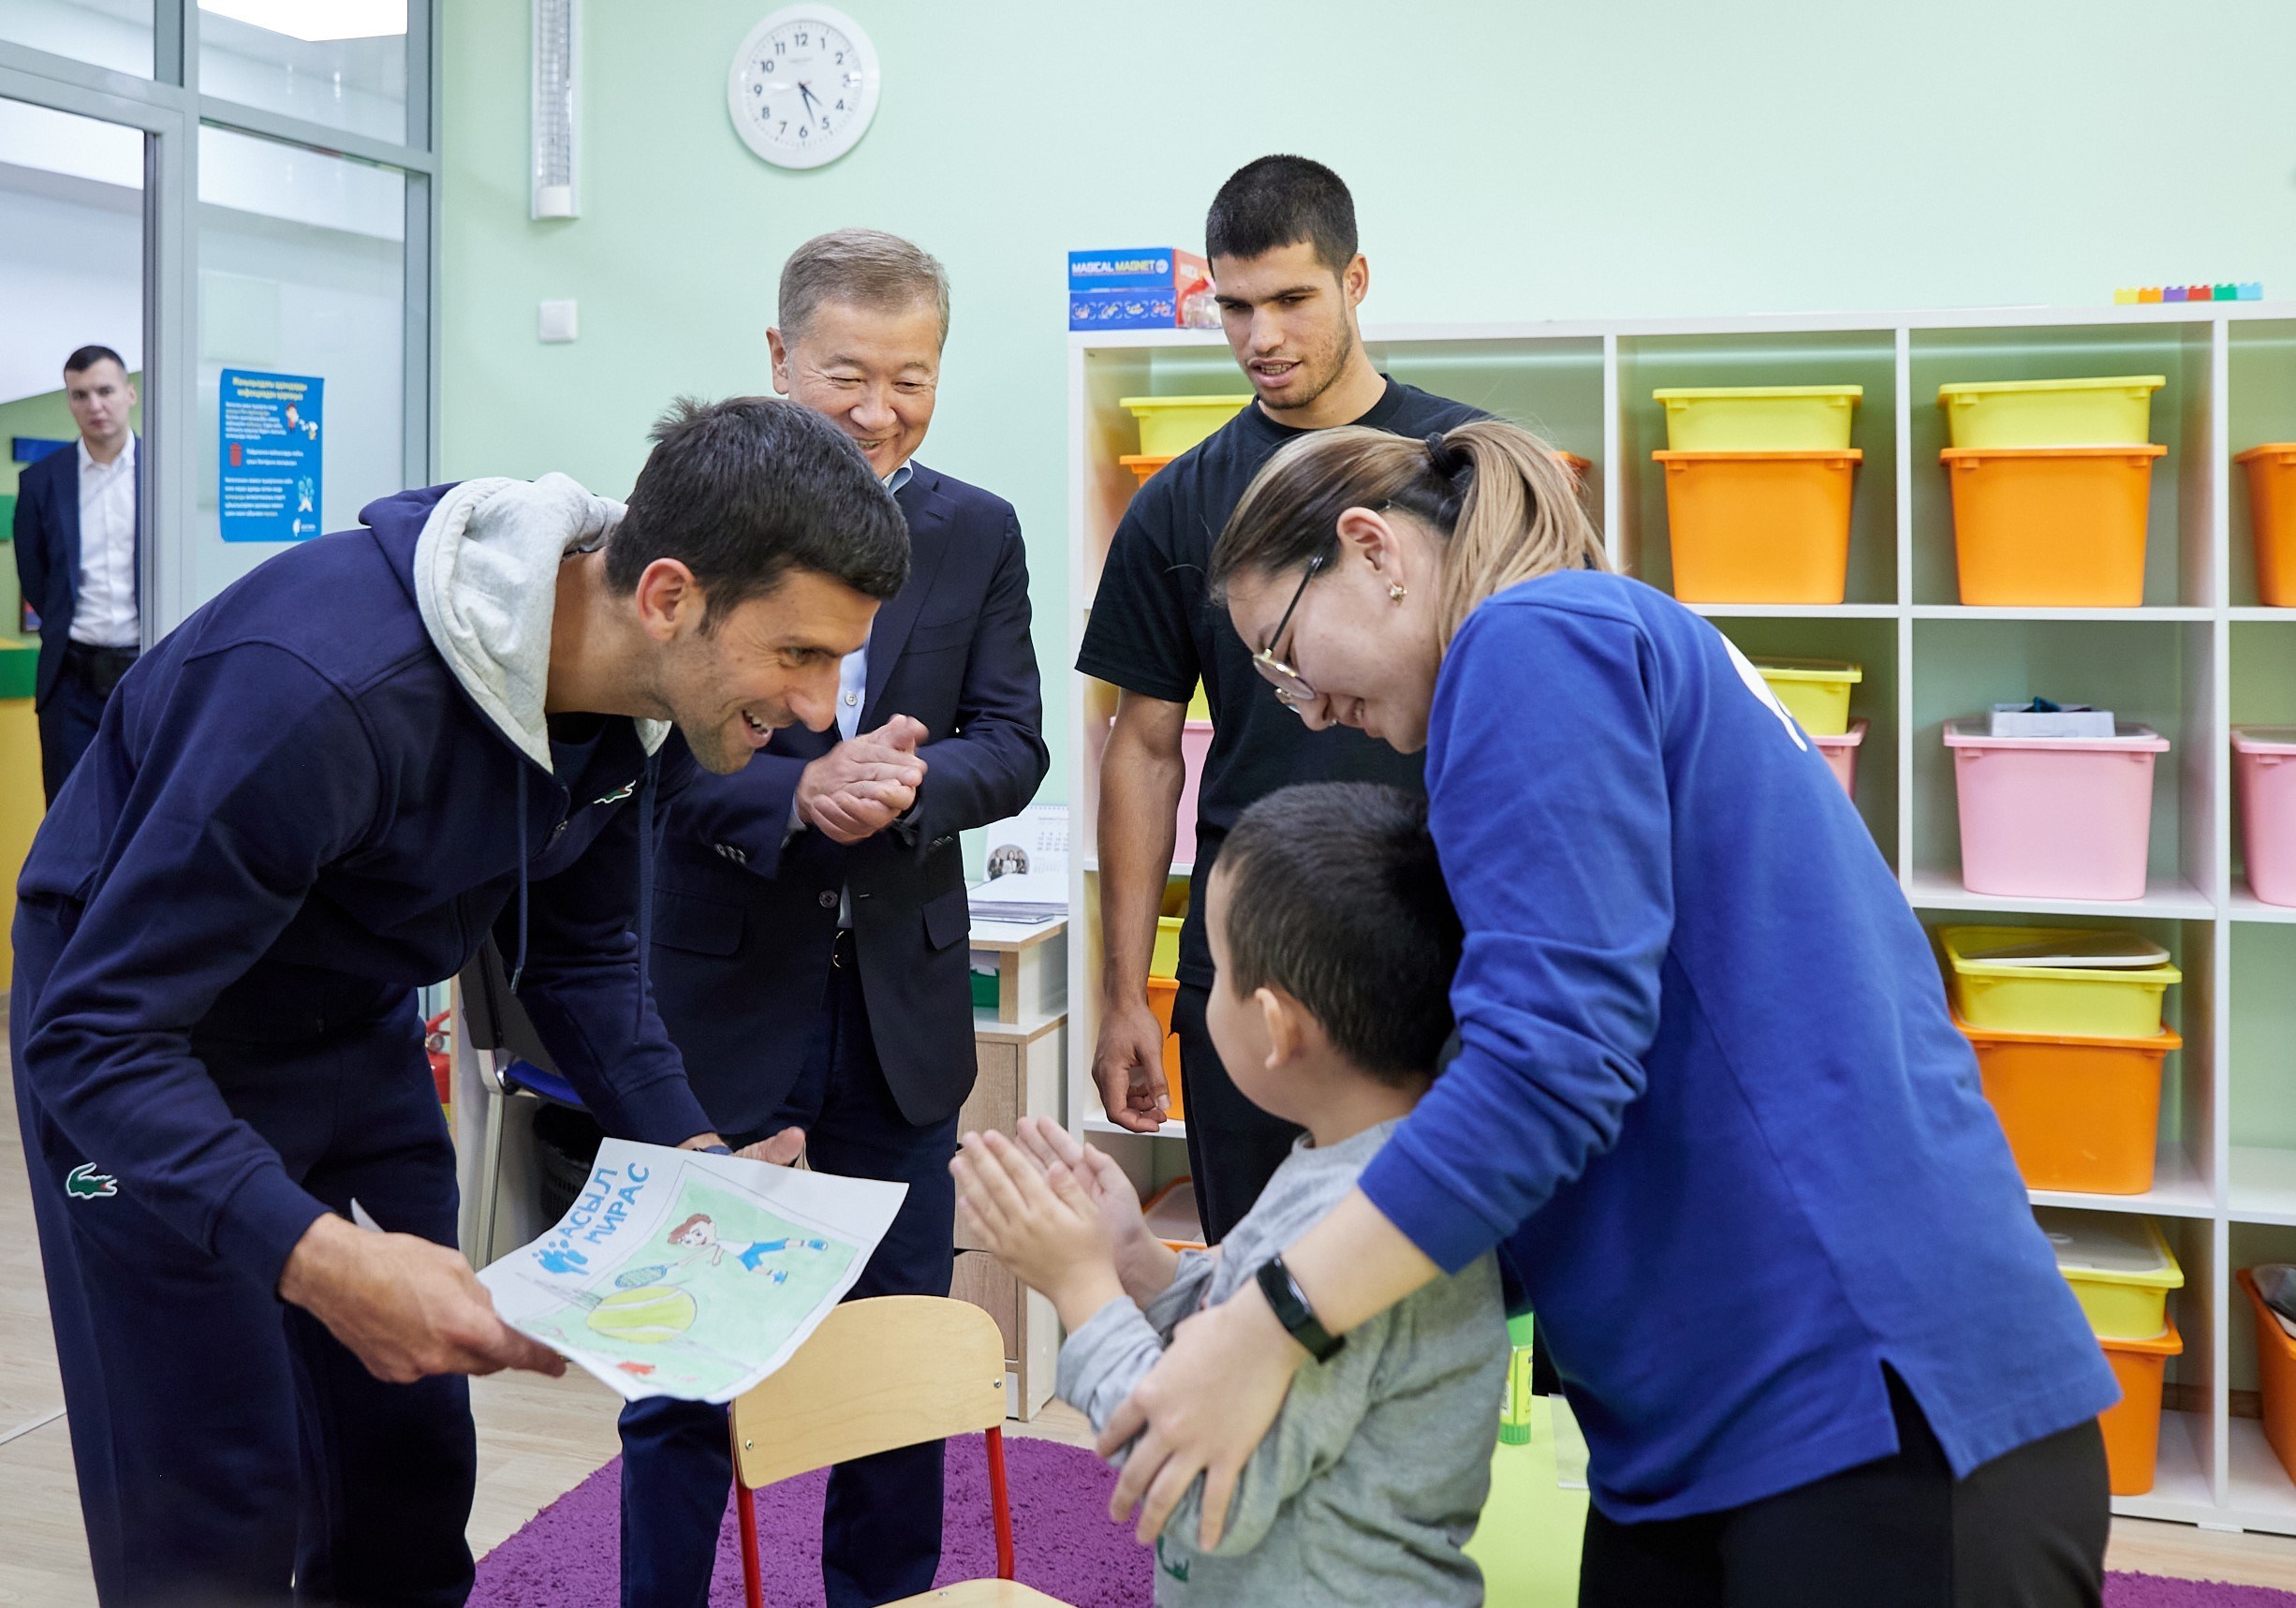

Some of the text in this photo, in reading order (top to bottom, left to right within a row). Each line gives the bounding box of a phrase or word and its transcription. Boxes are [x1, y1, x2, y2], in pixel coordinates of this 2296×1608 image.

[794, 34, 808, 47] 12
[820, 37, 826, 50] 1
[775, 42, 786, 56] 11
[835, 52, 844, 66] 2
[760, 60, 775, 74] 10
[754, 84, 763, 97] 9
[835, 99, 845, 111] 4
[762, 107, 771, 120] 8
[779, 122, 787, 135] 7
[822, 117, 830, 130] 5
[799, 125, 808, 139] 6
[1071, 258, 1155, 273] MAGICAL MAGNET
[558, 1168, 618, 1238] АСЫЛ
[583, 1162, 649, 1245] МИРАС
